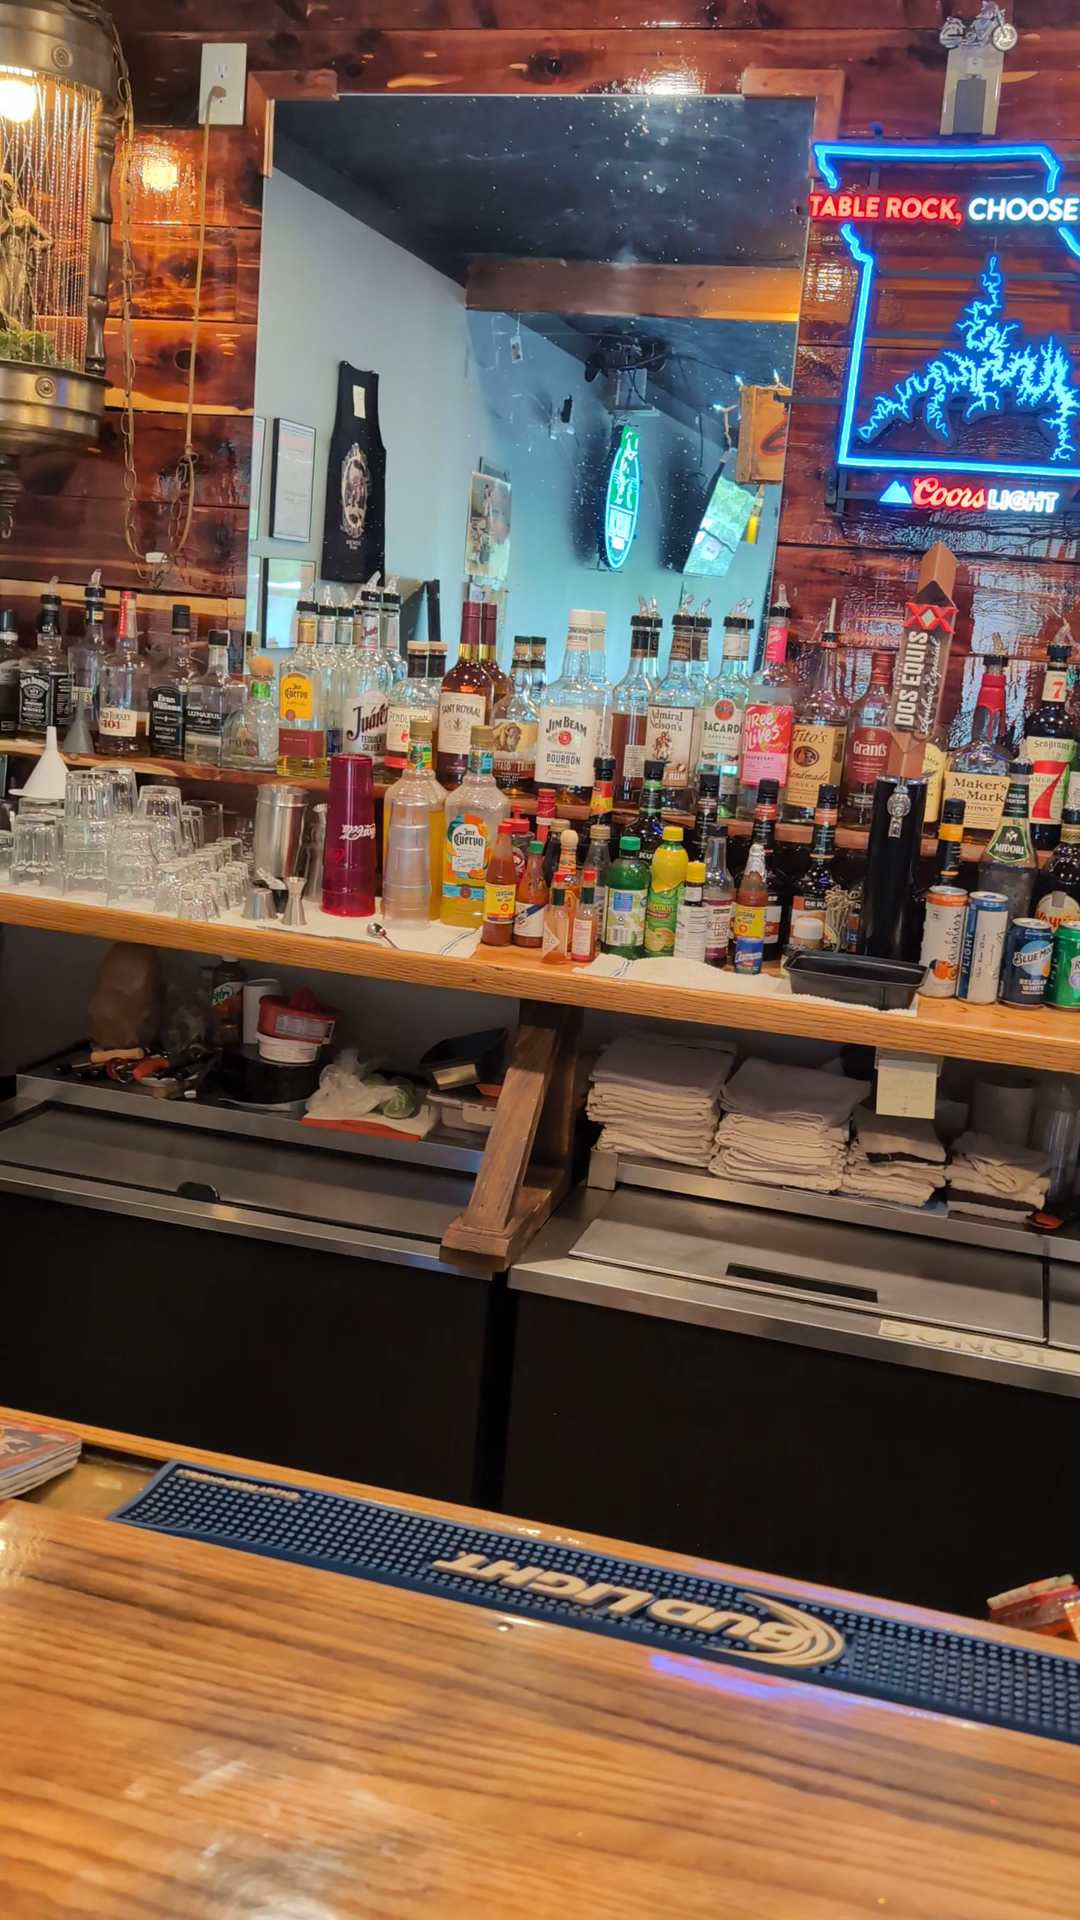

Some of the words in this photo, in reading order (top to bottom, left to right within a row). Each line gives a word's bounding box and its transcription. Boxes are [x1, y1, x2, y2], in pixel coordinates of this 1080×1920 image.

[809, 195, 880, 219] TABLE
[885, 197, 964, 226] ROCK,
[968, 197, 1079, 222] CHOOSE
[912, 476, 987, 509] Coors
[987, 488, 1059, 513] LIGHT
[901, 631, 929, 688] EQUIS
[922, 636, 941, 689] Especial
[284, 687, 308, 700] Cuervo
[1052, 682, 1064, 699] 7
[157, 694, 176, 703] Evan
[153, 701, 182, 712] Williams
[894, 689, 919, 727] DOS
[917, 689, 937, 735] Ambar
[187, 710, 222, 720] LUNAZUL
[546, 719, 562, 733] JIM
[563, 716, 587, 737] BEAM
[649, 720, 683, 732] Nelson's
[361, 735, 382, 744] TEQUILA
[362, 744, 380, 752] SILVER
[546, 753, 581, 765] BOURBON
[669, 771, 686, 780] RUM
[953, 777, 1007, 791] Maker's
[967, 790, 1006, 802] Mark
[454, 832, 484, 847] Cuervo
[994, 842, 1025, 855] MIDORI
[961, 932, 975, 975] FLIGHT
[1013, 951, 1040, 965] BLUE
[432, 1553, 656, 1616] LIGHT
[647, 1598, 817, 1653] BUD
